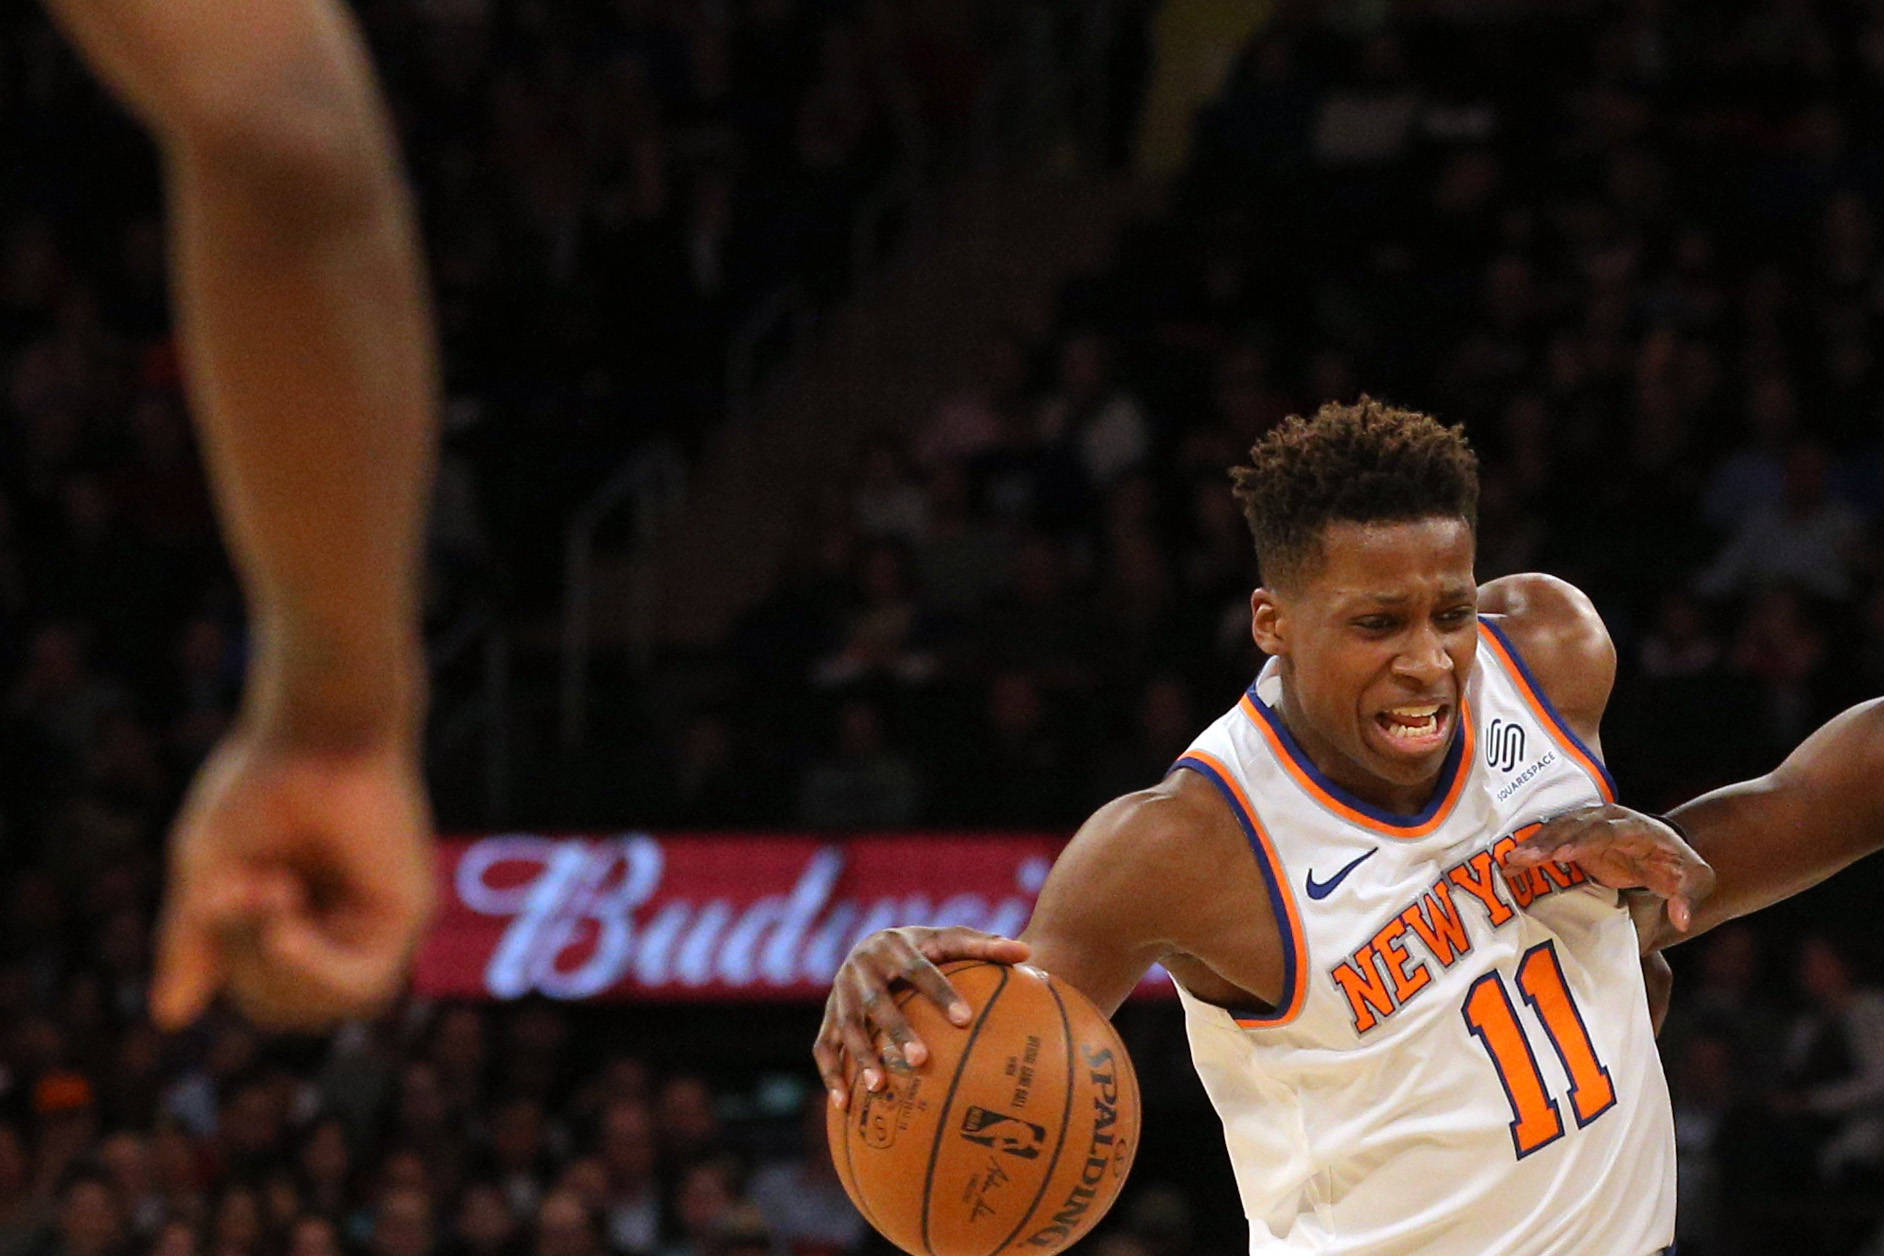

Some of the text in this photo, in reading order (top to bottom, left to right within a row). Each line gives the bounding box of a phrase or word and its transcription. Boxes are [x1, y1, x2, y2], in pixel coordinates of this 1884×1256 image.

[1496, 751, 1557, 803] SQUARESPACE
[453, 833, 1052, 1000] Budwei
[1331, 821, 1588, 1036] NEW YOR
[1026, 1042, 1119, 1248] SPALDING
[1461, 938, 1617, 1161] 11
